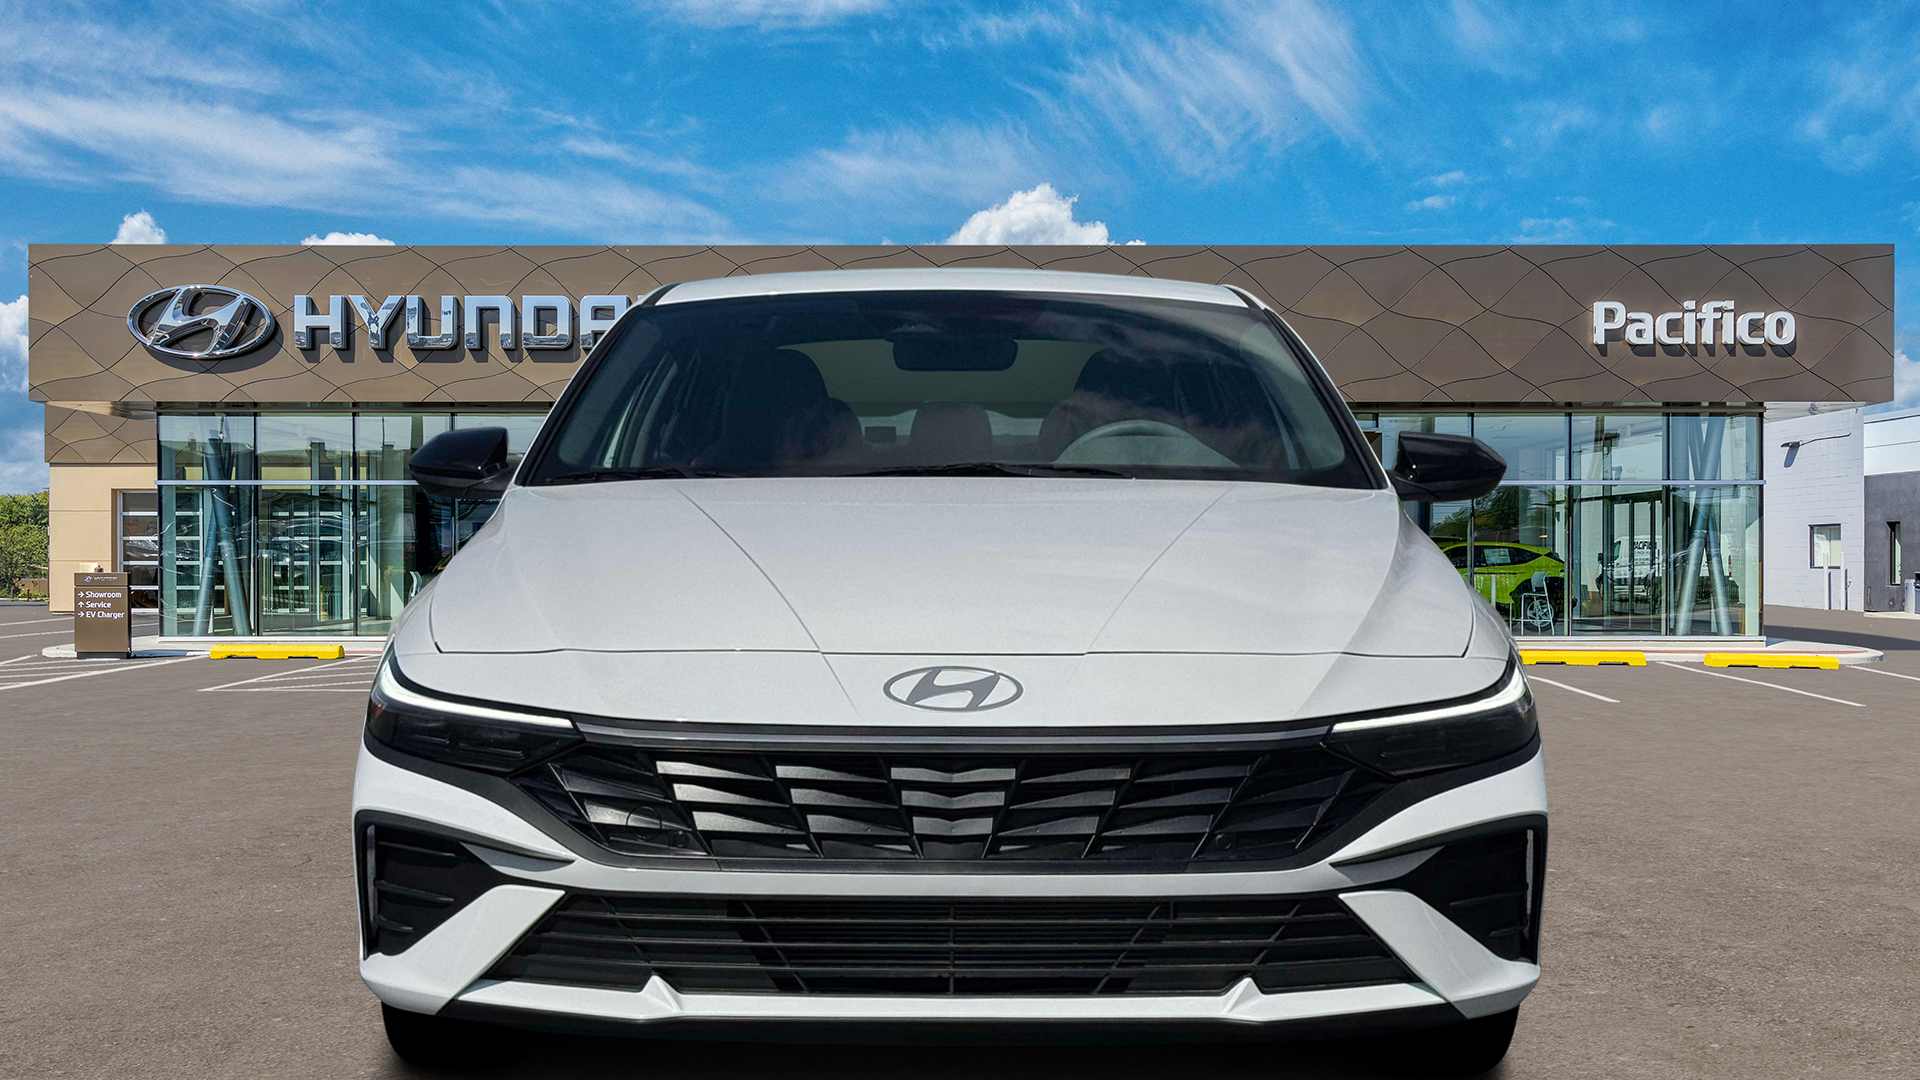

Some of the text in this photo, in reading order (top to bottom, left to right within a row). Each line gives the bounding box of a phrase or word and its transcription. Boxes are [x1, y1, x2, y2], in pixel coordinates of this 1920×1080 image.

[294, 294, 646, 351] HYUNDA
[1593, 300, 1797, 346] Pacifico
[85, 590, 122, 599] Showroom
[85, 601, 112, 609] Service
[97, 611, 125, 619] Charger
